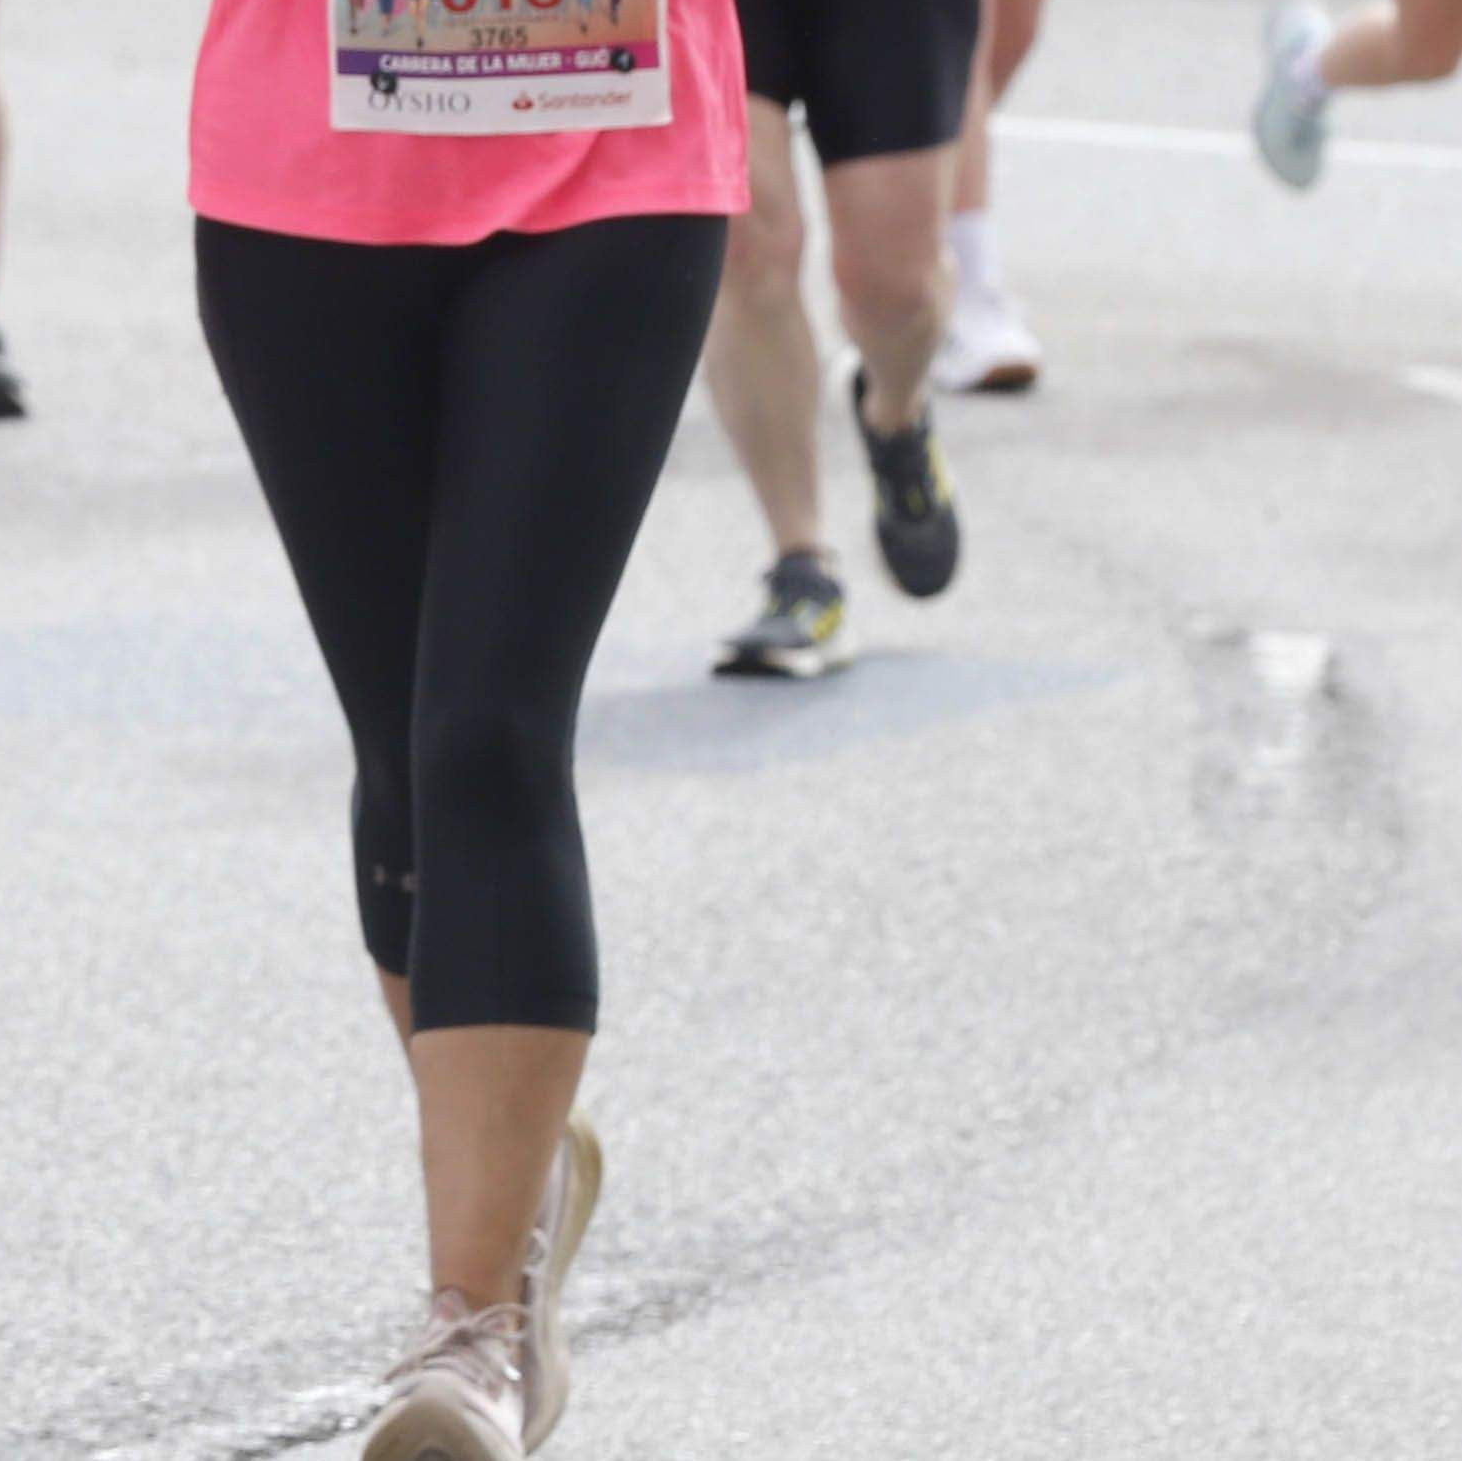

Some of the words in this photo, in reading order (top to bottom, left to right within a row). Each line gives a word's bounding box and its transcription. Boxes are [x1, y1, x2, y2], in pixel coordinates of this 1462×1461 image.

[472, 27, 528, 48] 3765
[379, 54, 453, 73] CARRERA
[456, 55, 477, 73] DE
[481, 53, 503, 73] LA
[369, 89, 471, 115] OYSHO
[538, 89, 632, 110] Santander
